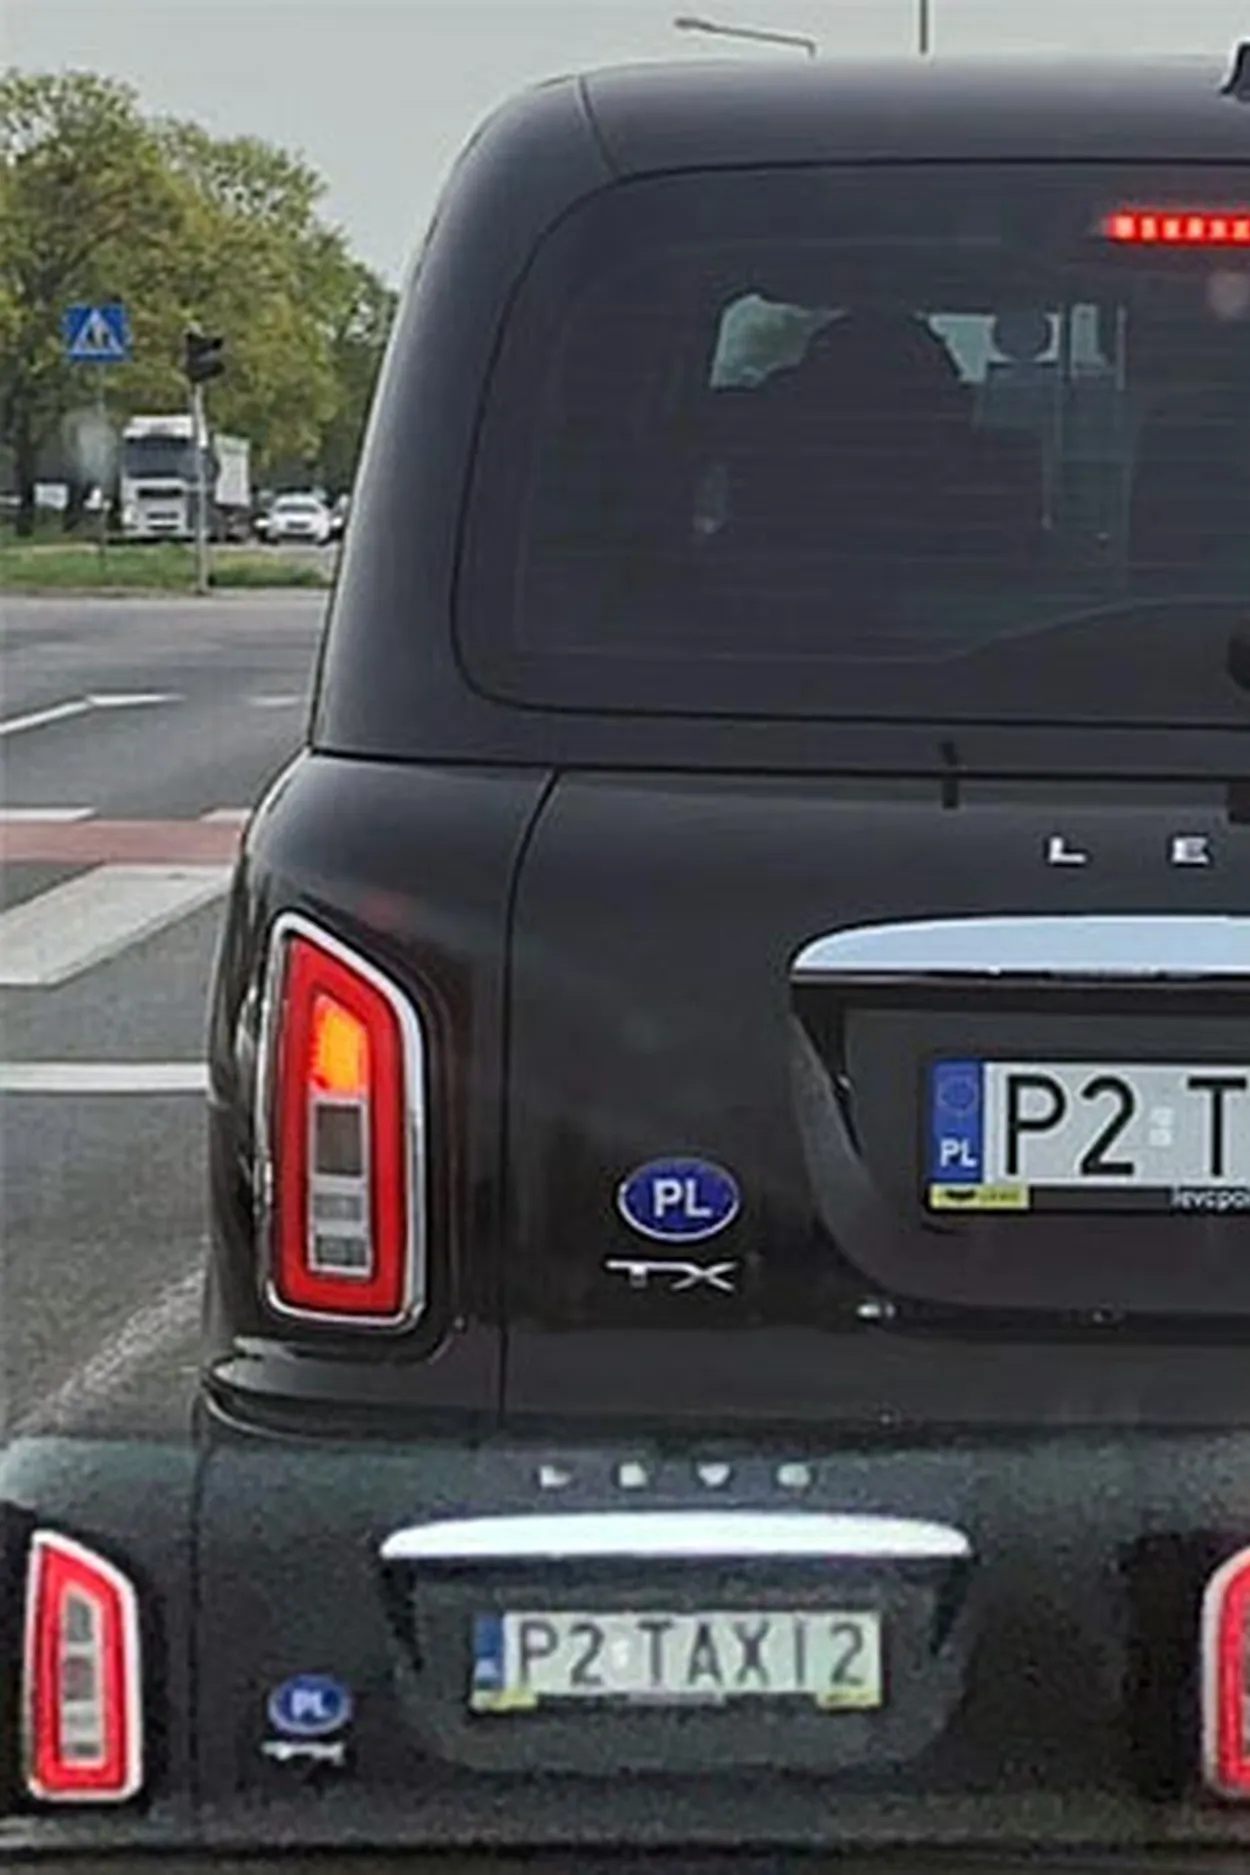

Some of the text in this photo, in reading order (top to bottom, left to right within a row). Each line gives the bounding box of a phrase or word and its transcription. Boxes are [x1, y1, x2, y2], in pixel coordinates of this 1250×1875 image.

[1005, 1073, 1136, 1176] P2
[939, 1137, 978, 1168] PL
[653, 1178, 713, 1218] PL
[605, 1258, 738, 1292] TX
[519, 1619, 605, 1688] P2
